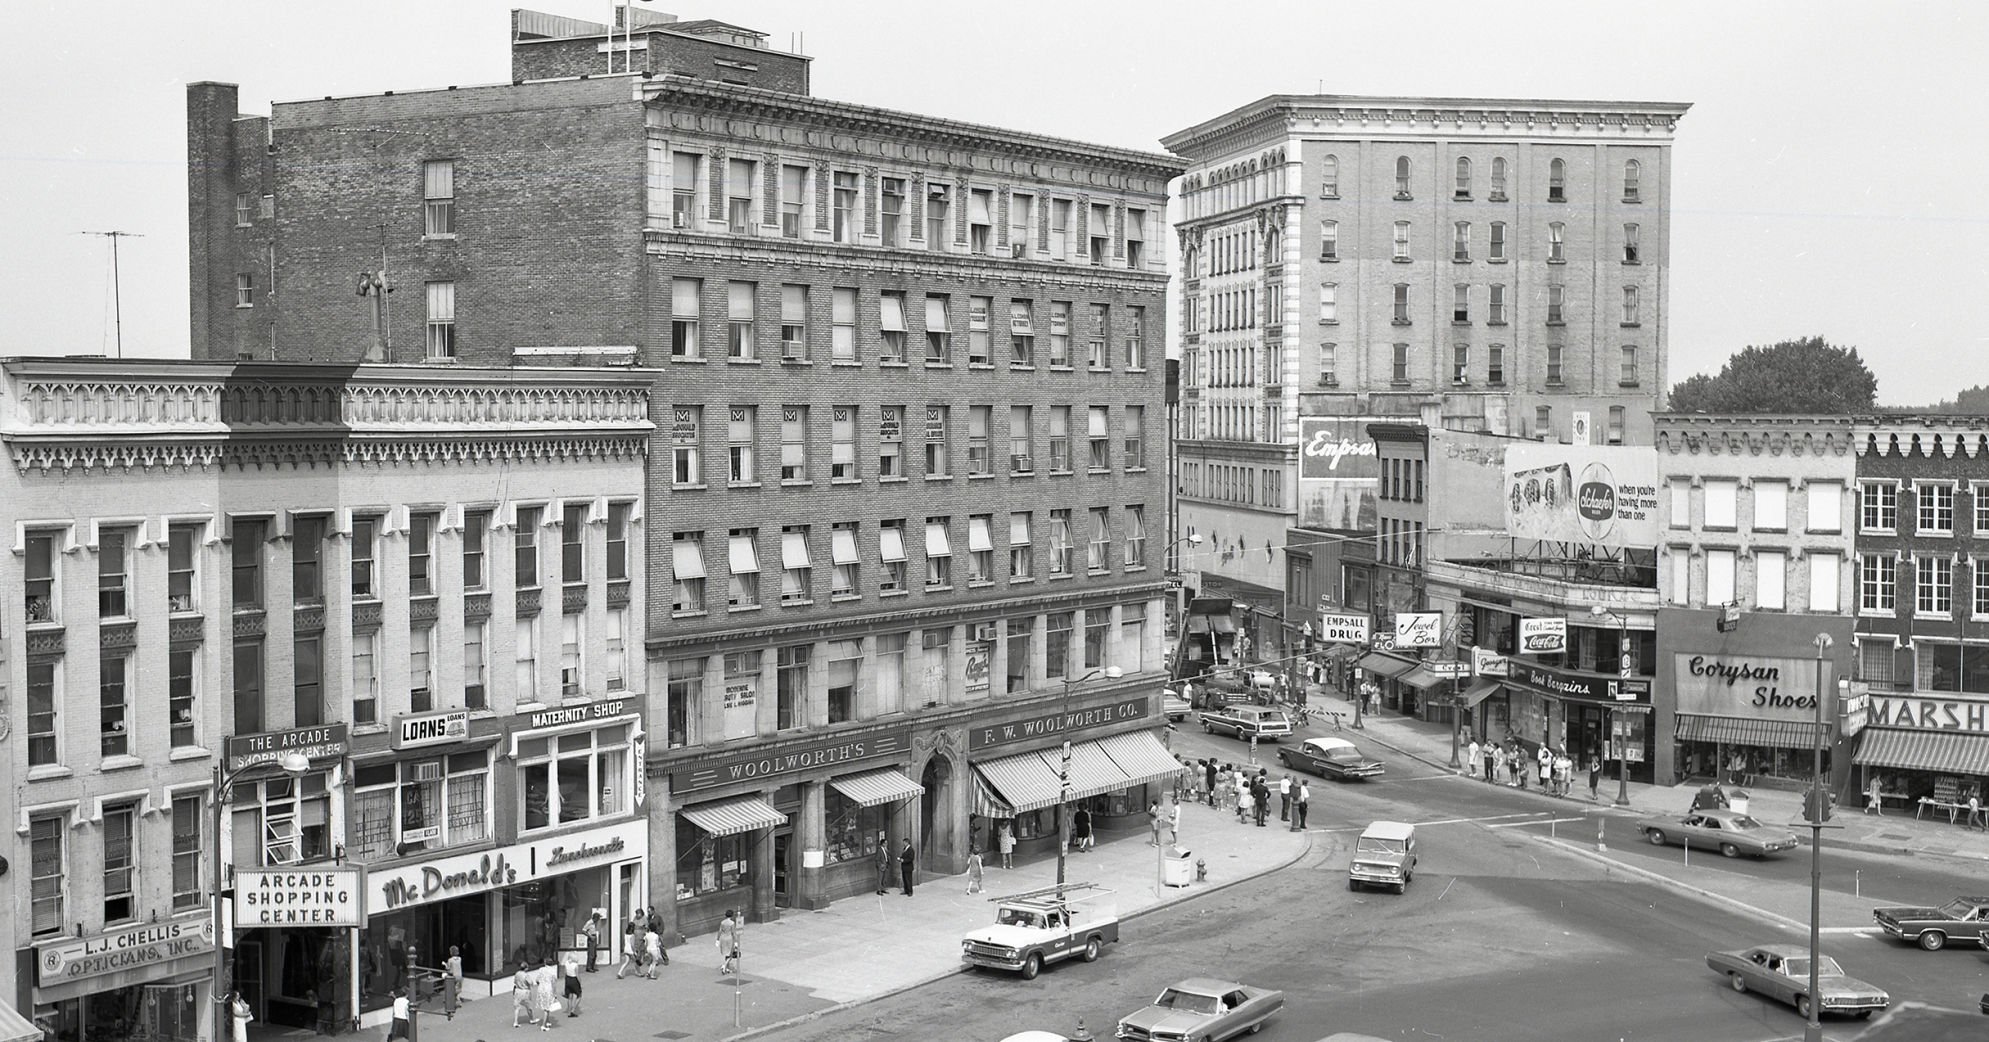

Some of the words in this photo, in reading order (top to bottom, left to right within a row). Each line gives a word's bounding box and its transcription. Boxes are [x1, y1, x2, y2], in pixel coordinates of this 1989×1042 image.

[1580, 487, 1613, 510] Schaefer
[1618, 484, 1636, 495] when
[1637, 485, 1656, 497] you're
[1618, 497, 1639, 509] having
[1640, 499, 1657, 508] more
[1618, 509, 1632, 520] than
[1633, 511, 1646, 520] one
[1326, 617, 1365, 628] EMPSALL
[1399, 616, 1438, 635] Jewel
[1330, 628, 1363, 639] DRUG
[1412, 631, 1436, 645] Box
[1688, 655, 1780, 688] Corysan
[1752, 686, 1817, 709] Shoes
[447, 712, 466, 722] LOANS
[532, 706, 588, 728] MATERNITY
[594, 701, 623, 718] SHOP
[402, 718, 446, 742] LOANS
[984, 729, 996, 744] F.
[1003, 725, 1016, 740] W.
[1023, 707, 1113, 737] WOOLWORTH
[1118, 703, 1138, 718] CO.
[249, 736, 273, 751] THE
[282, 728, 330, 748] ARCADE
[298, 743, 341, 759] CENTER
[729, 743, 865, 780] WOOLWORTH'S
[260, 874, 335, 888] ARCADE
[247, 891, 348, 905] SHOPPING
[260, 908, 335, 922] CENTER
[117, 924, 181, 949] CHELLIS
